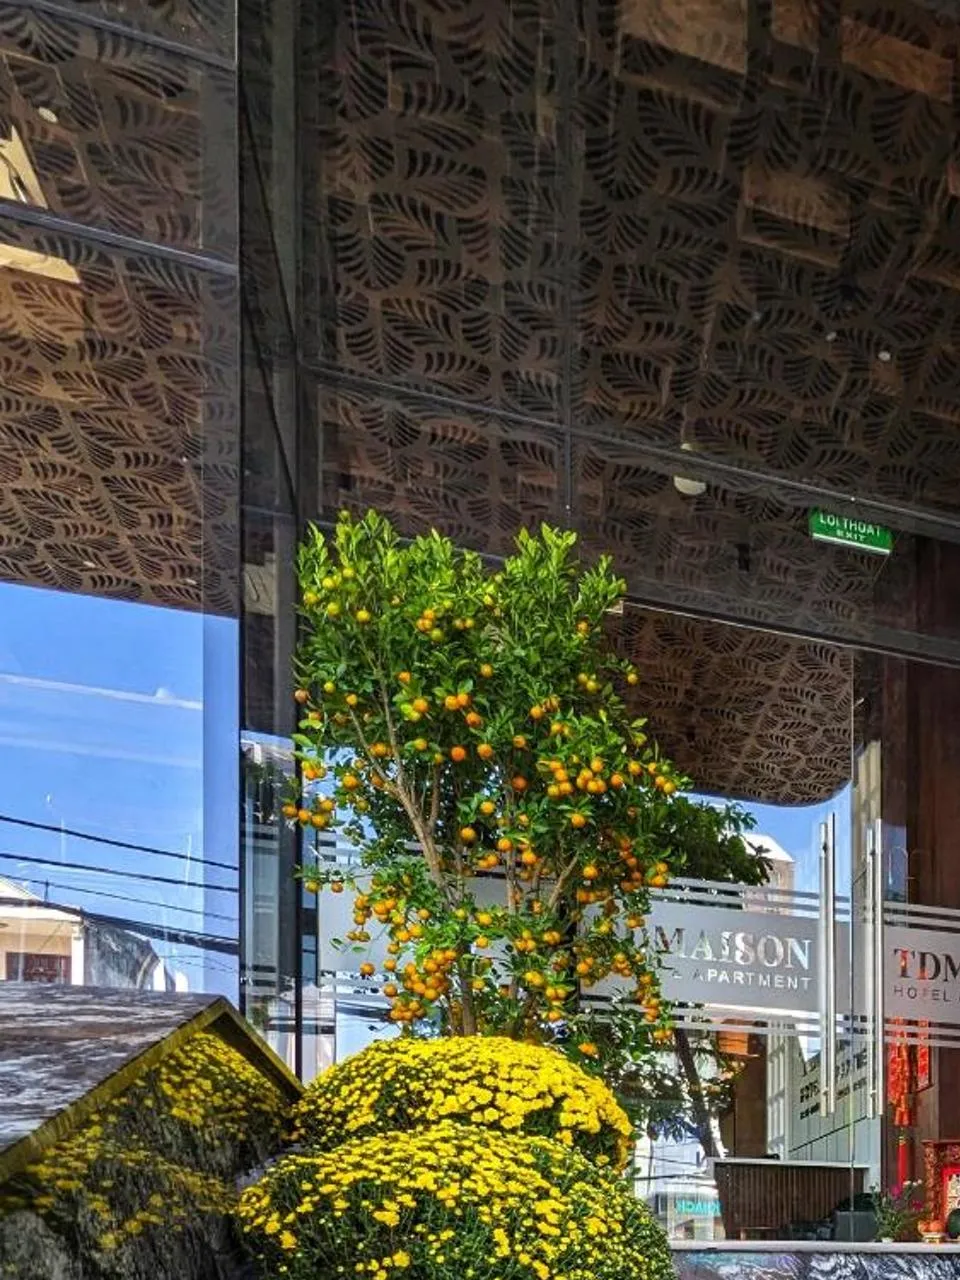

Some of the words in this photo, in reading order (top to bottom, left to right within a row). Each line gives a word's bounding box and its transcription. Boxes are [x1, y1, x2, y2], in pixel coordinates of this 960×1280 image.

[836, 529, 867, 541] EXIT
[640, 925, 812, 970] MAISON
[893, 984, 950, 1003] HOTEL
